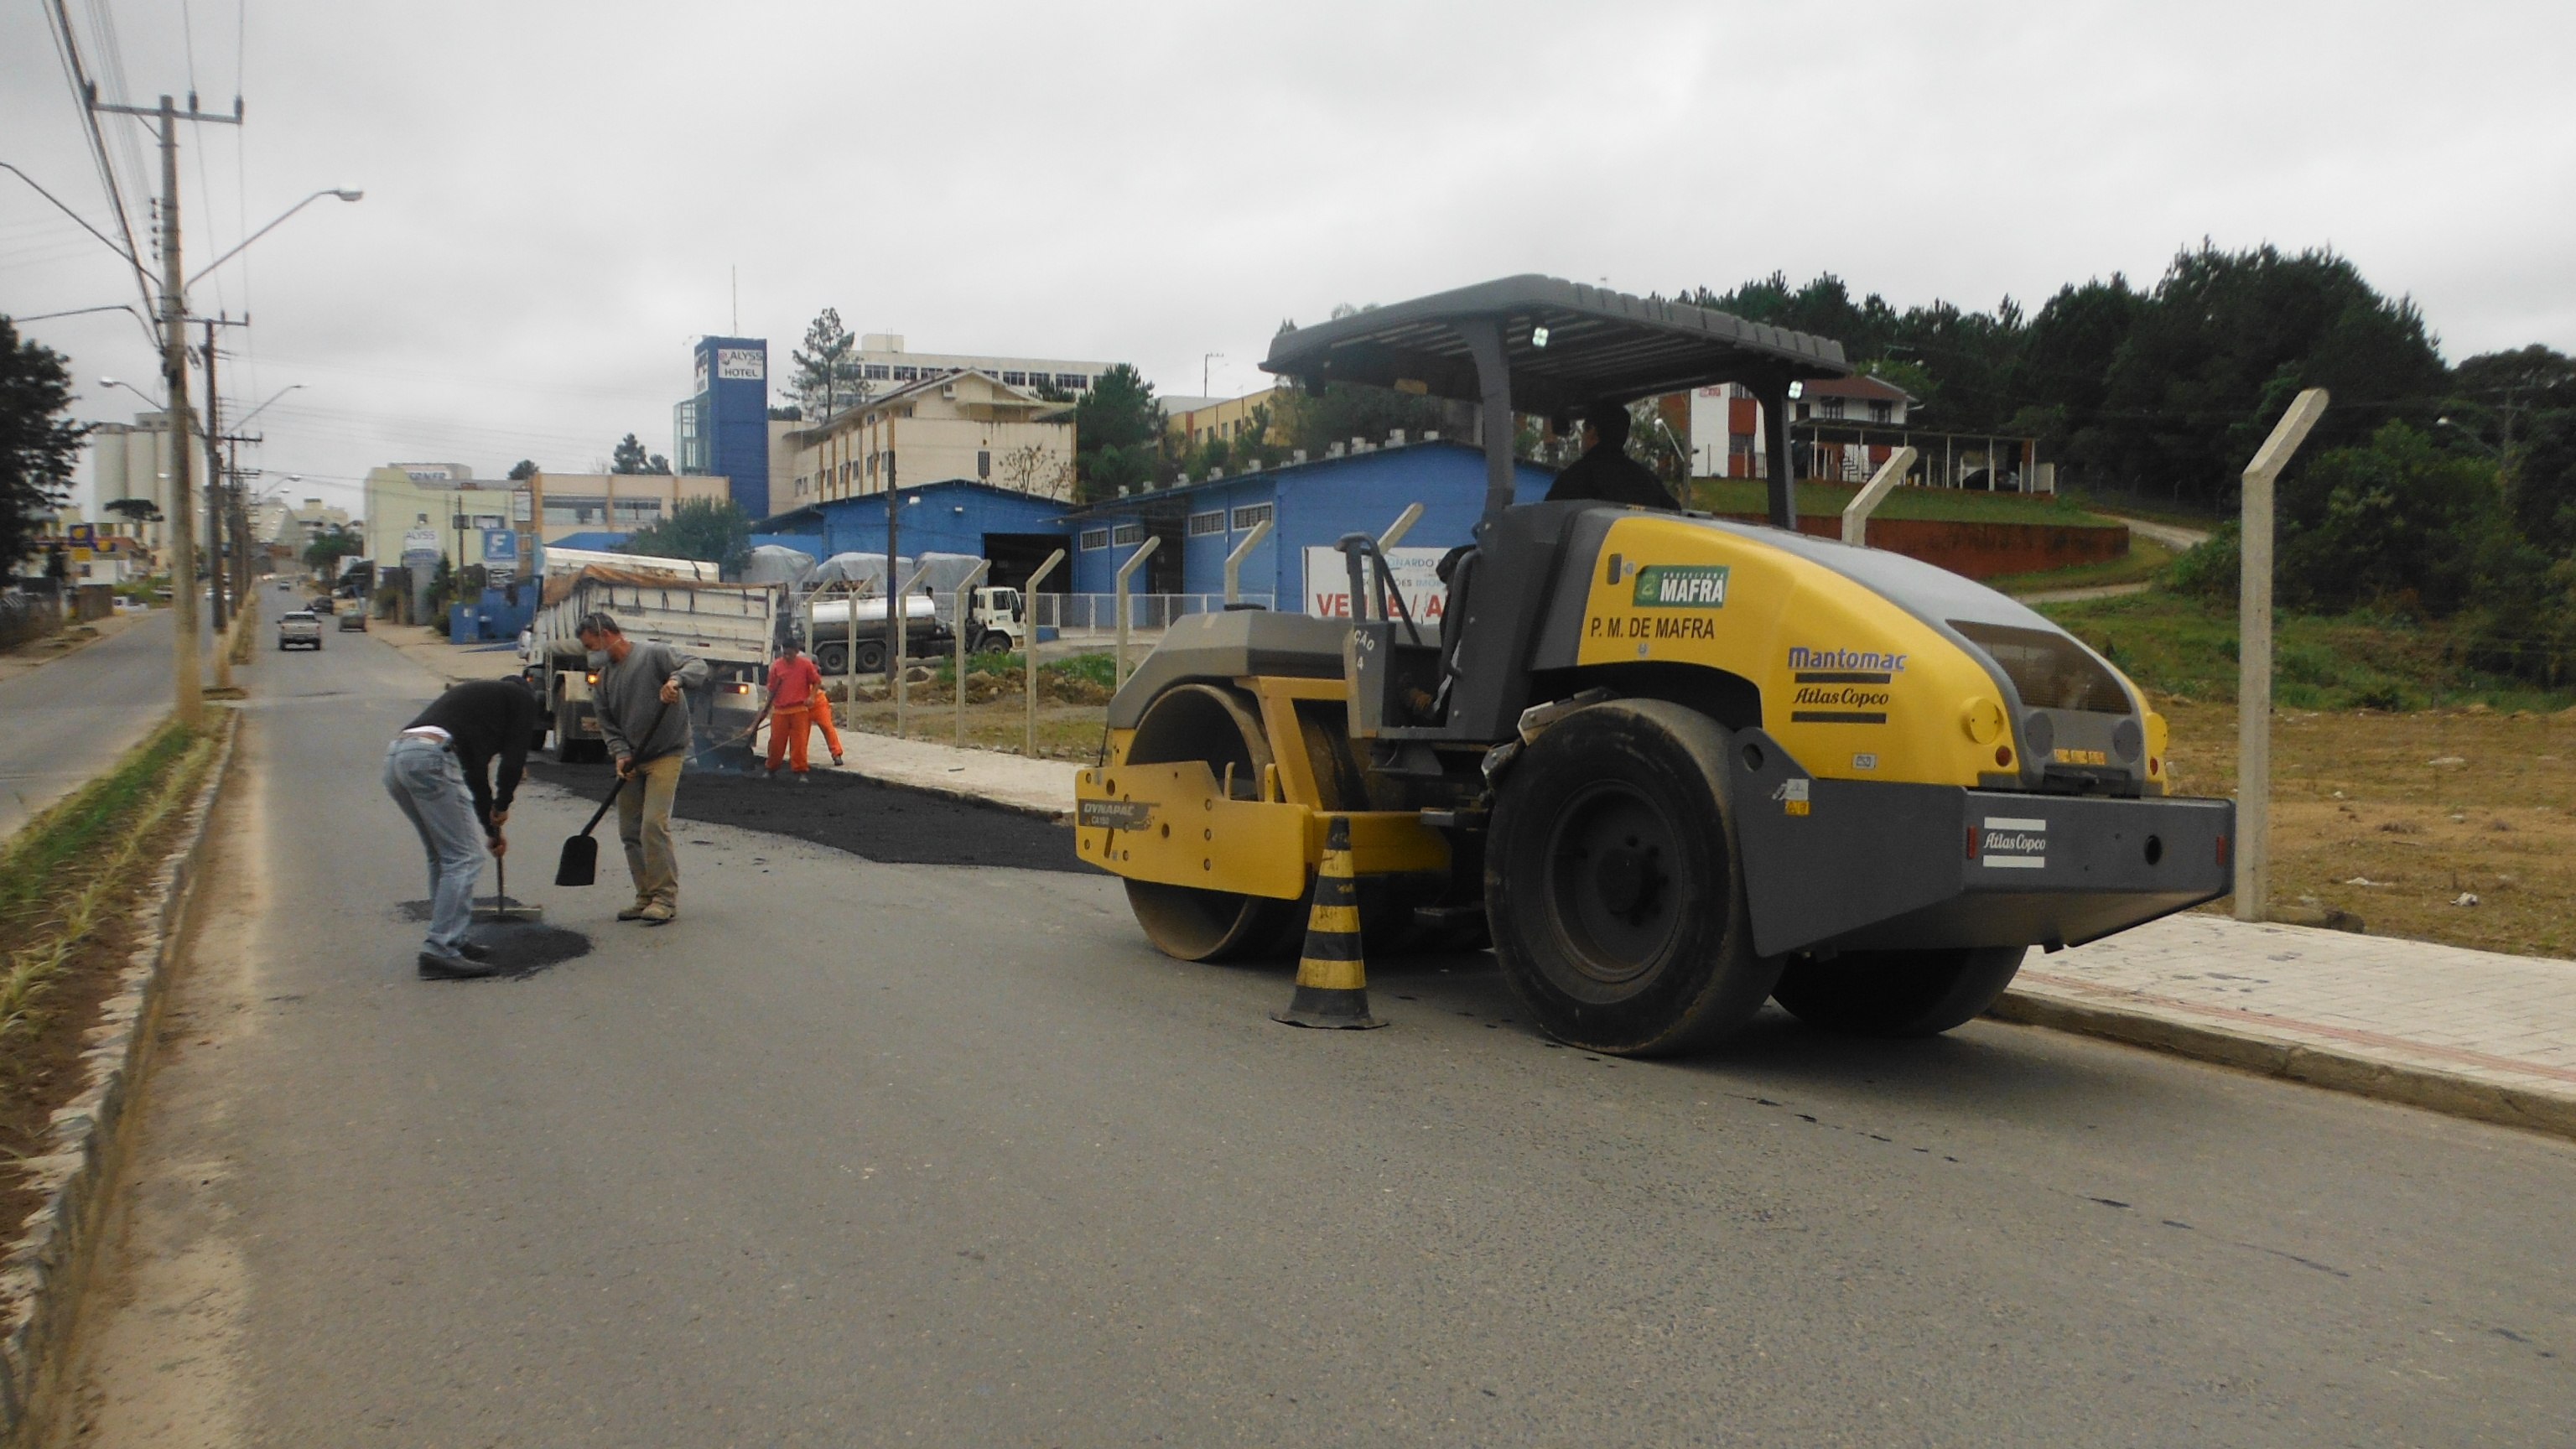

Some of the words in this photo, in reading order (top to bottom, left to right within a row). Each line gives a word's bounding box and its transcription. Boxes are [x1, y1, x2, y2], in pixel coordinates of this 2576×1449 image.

[724, 368, 758, 377] HOTEL
[1660, 579, 1723, 602] MAFRA
[1317, 594, 1402, 617] VEE
[1591, 617, 1602, 637] P.
[1607, 618, 1623, 637] M.
[1629, 617, 1651, 638] DE
[1655, 618, 1715, 639] MAFRA
[1788, 647, 1907, 670] Mantomac
[1793, 688, 1839, 704] Atlas
[1841, 688, 1888, 708] Copco
[1084, 803, 1135, 816] DYNAPAC
[1984, 832, 2015, 849] Atlas
[2016, 833, 2046, 853] Copco
